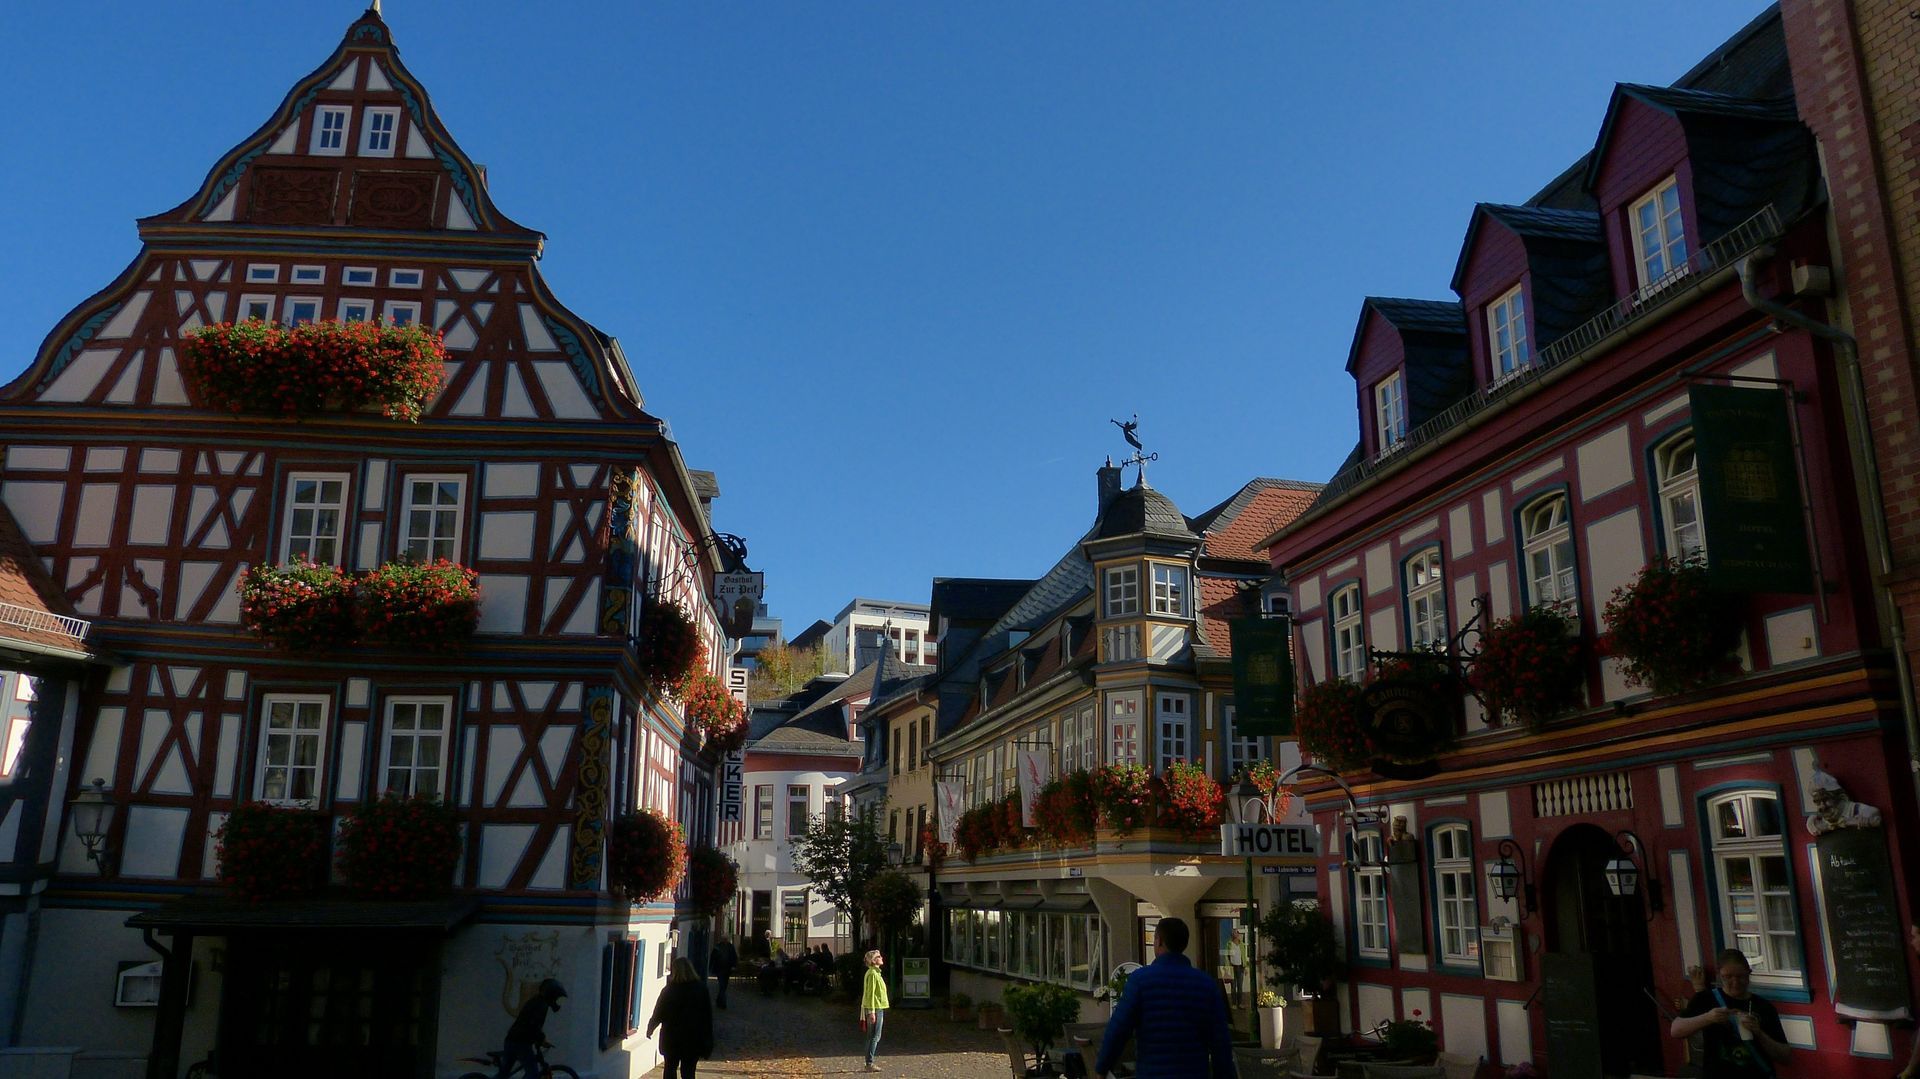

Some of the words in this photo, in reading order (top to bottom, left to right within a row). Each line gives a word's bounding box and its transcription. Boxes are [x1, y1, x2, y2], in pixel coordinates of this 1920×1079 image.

[724, 575, 753, 584] Gasthof
[719, 584, 736, 594] Zur
[1239, 827, 1314, 853] HOTEL
